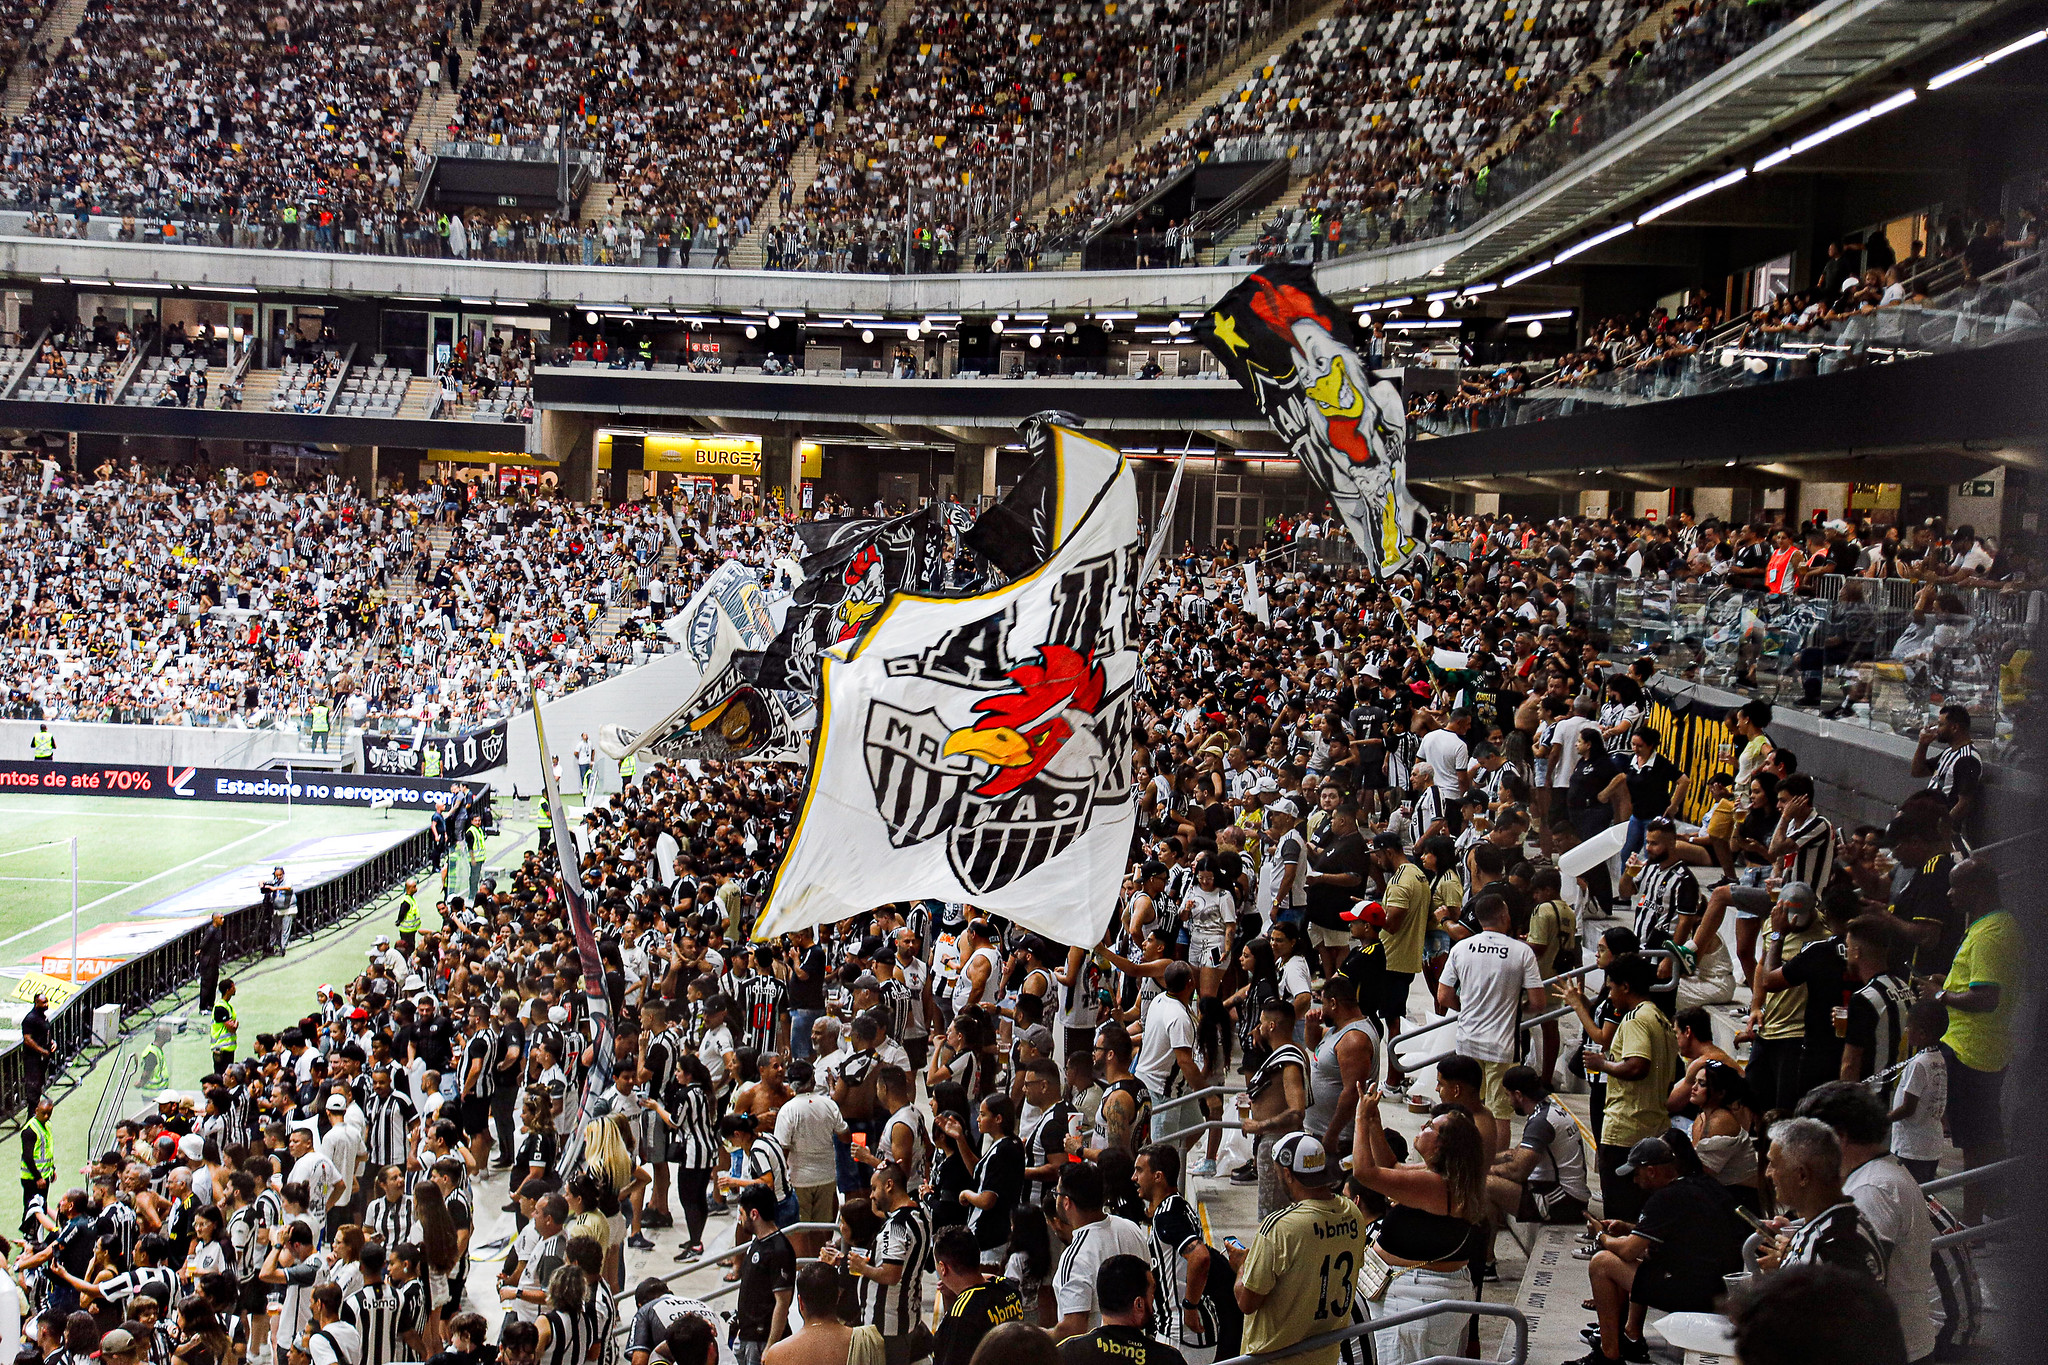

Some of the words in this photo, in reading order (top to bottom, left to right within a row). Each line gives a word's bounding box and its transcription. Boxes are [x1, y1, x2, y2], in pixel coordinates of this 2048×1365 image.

[43, 771, 66, 787] de
[71, 772, 100, 789] até
[104, 771, 151, 791] 70%
[216, 779, 301, 797] Estacione
[306, 784, 330, 798] no
[333, 785, 420, 806] aeroporto
[1477, 943, 1509, 959] bmg
[1325, 1219, 1358, 1239] bmg
[1314, 1251, 1354, 1320] 13
[373, 1299, 397, 1311] bmg
[995, 1299, 1024, 1322] bmg
[1109, 1338, 1146, 1365] bmg
